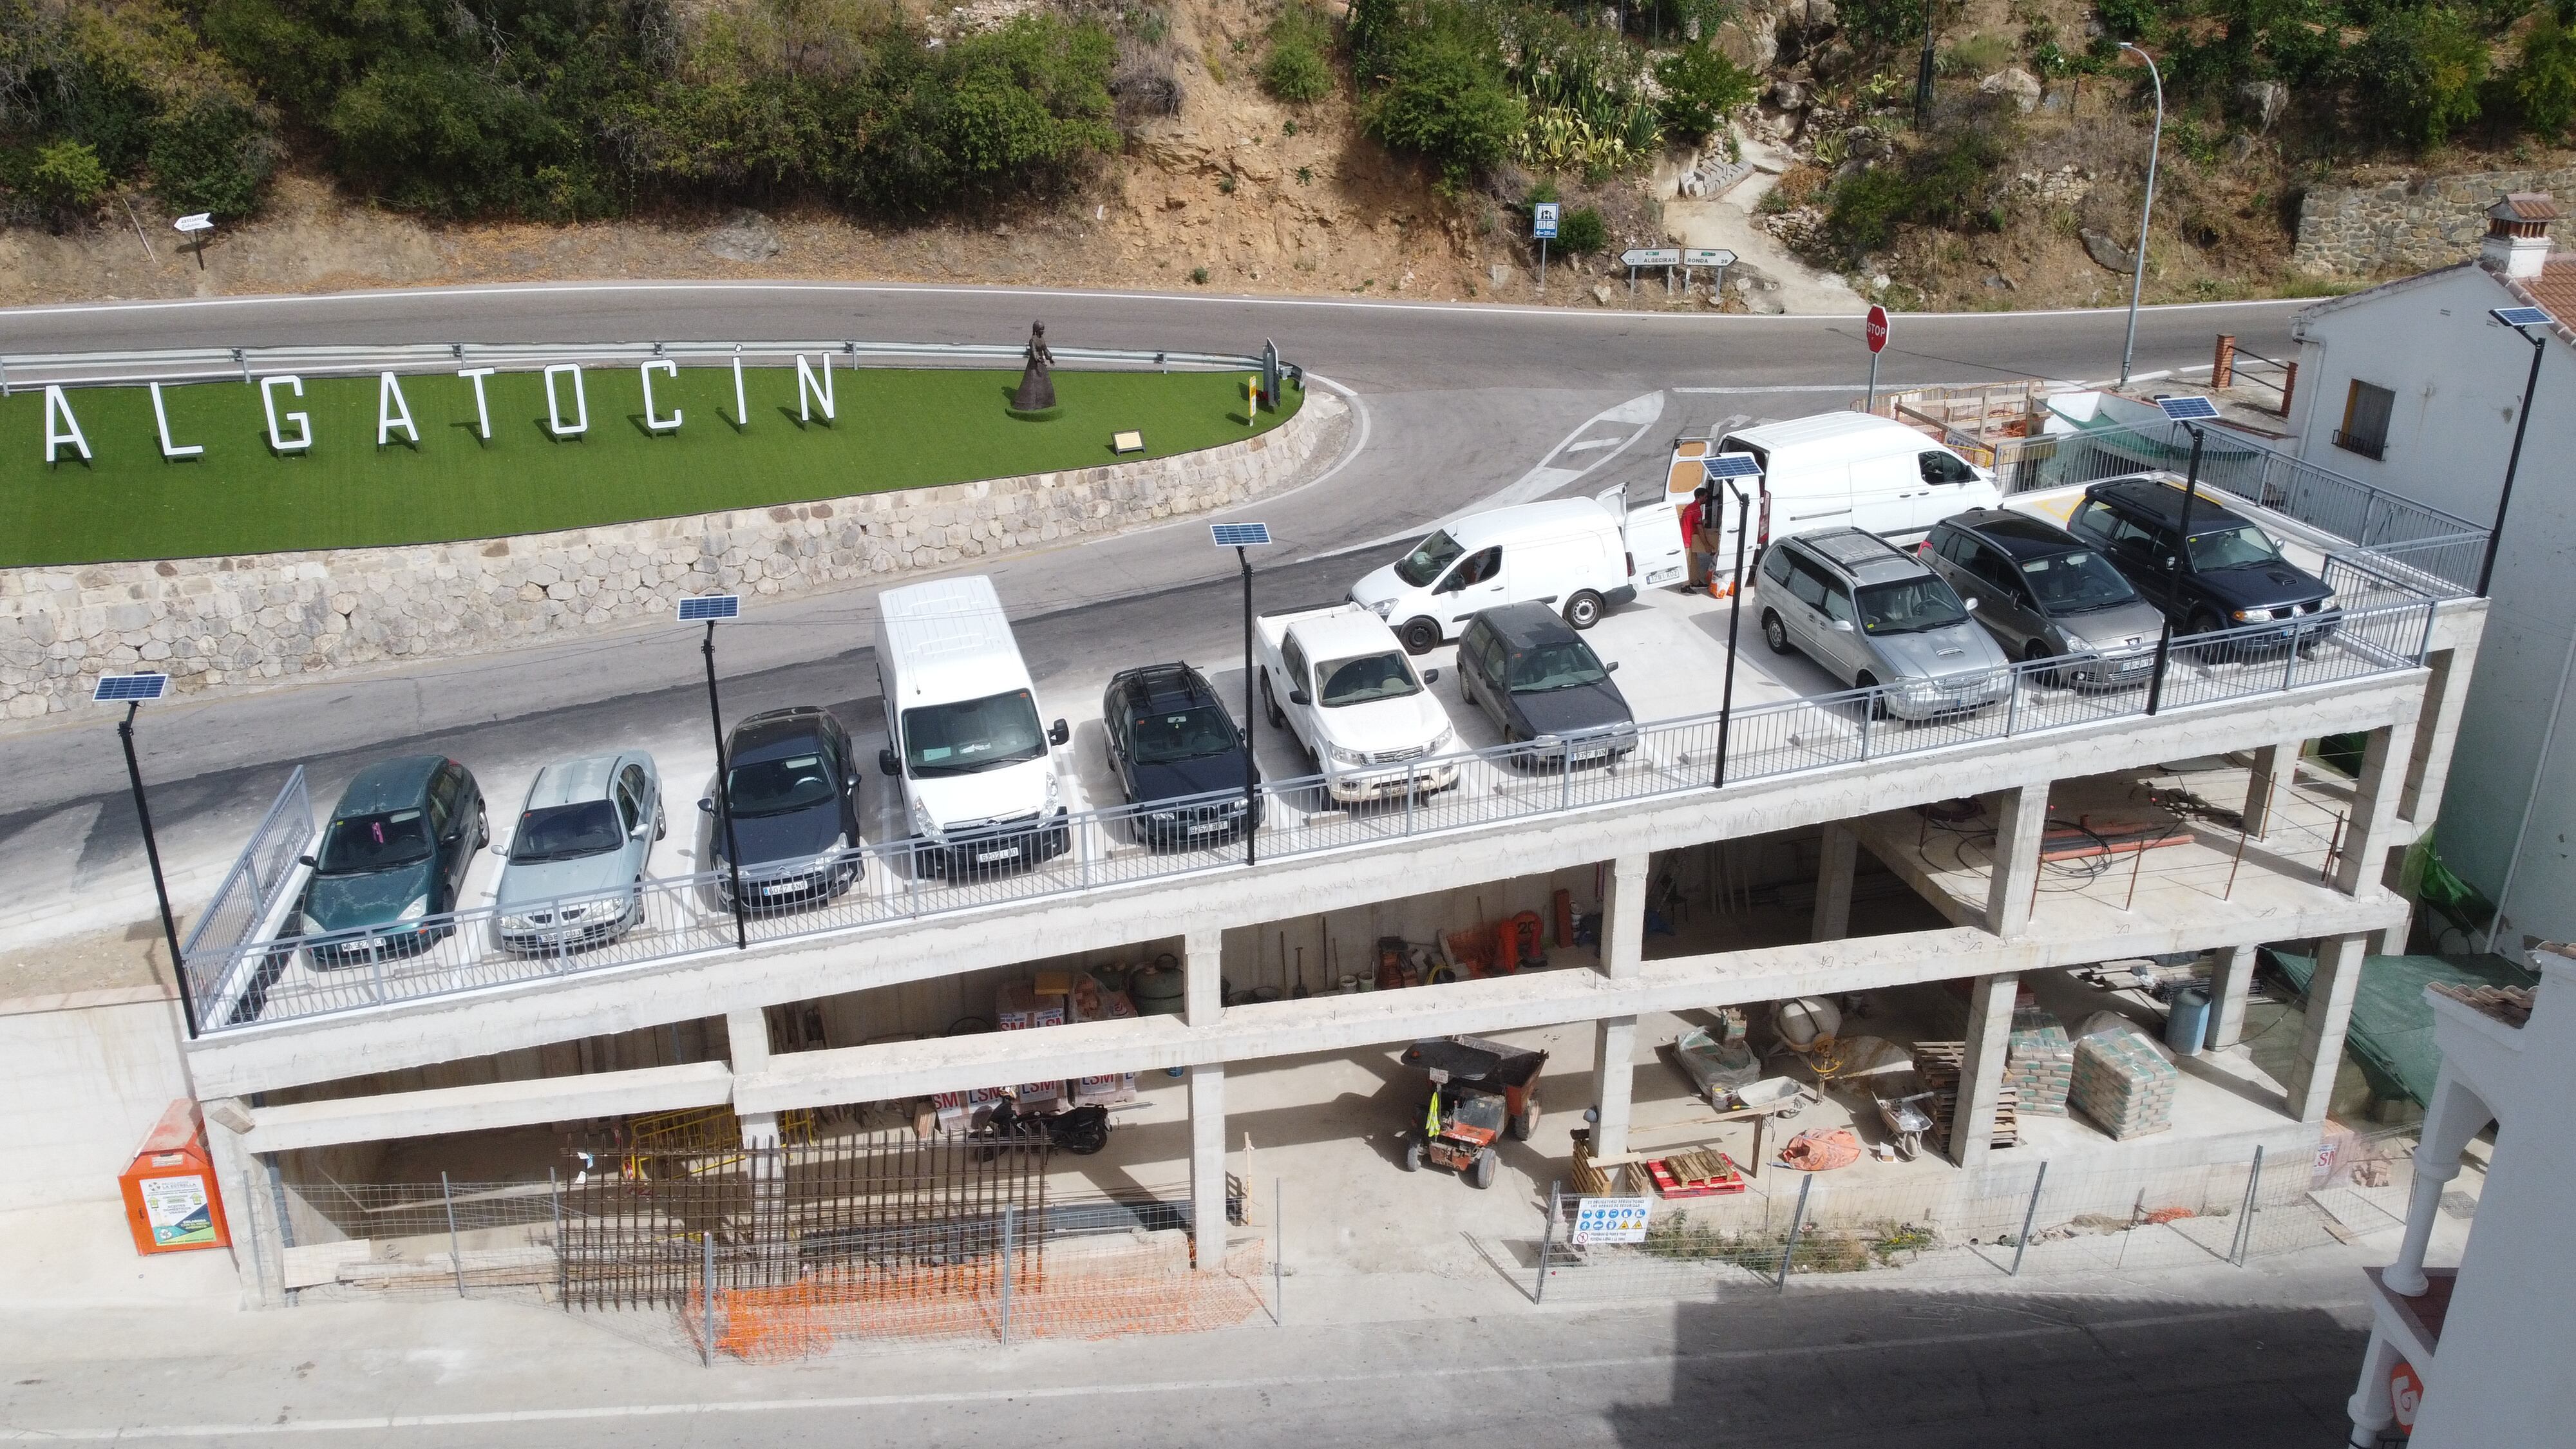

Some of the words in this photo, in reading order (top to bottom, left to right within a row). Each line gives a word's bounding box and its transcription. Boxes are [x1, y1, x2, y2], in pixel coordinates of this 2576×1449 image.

[1867, 322, 1886, 337] STOP
[1082, 1074, 1113, 1085] LSM
[1021, 1080, 1055, 1094] LSM
